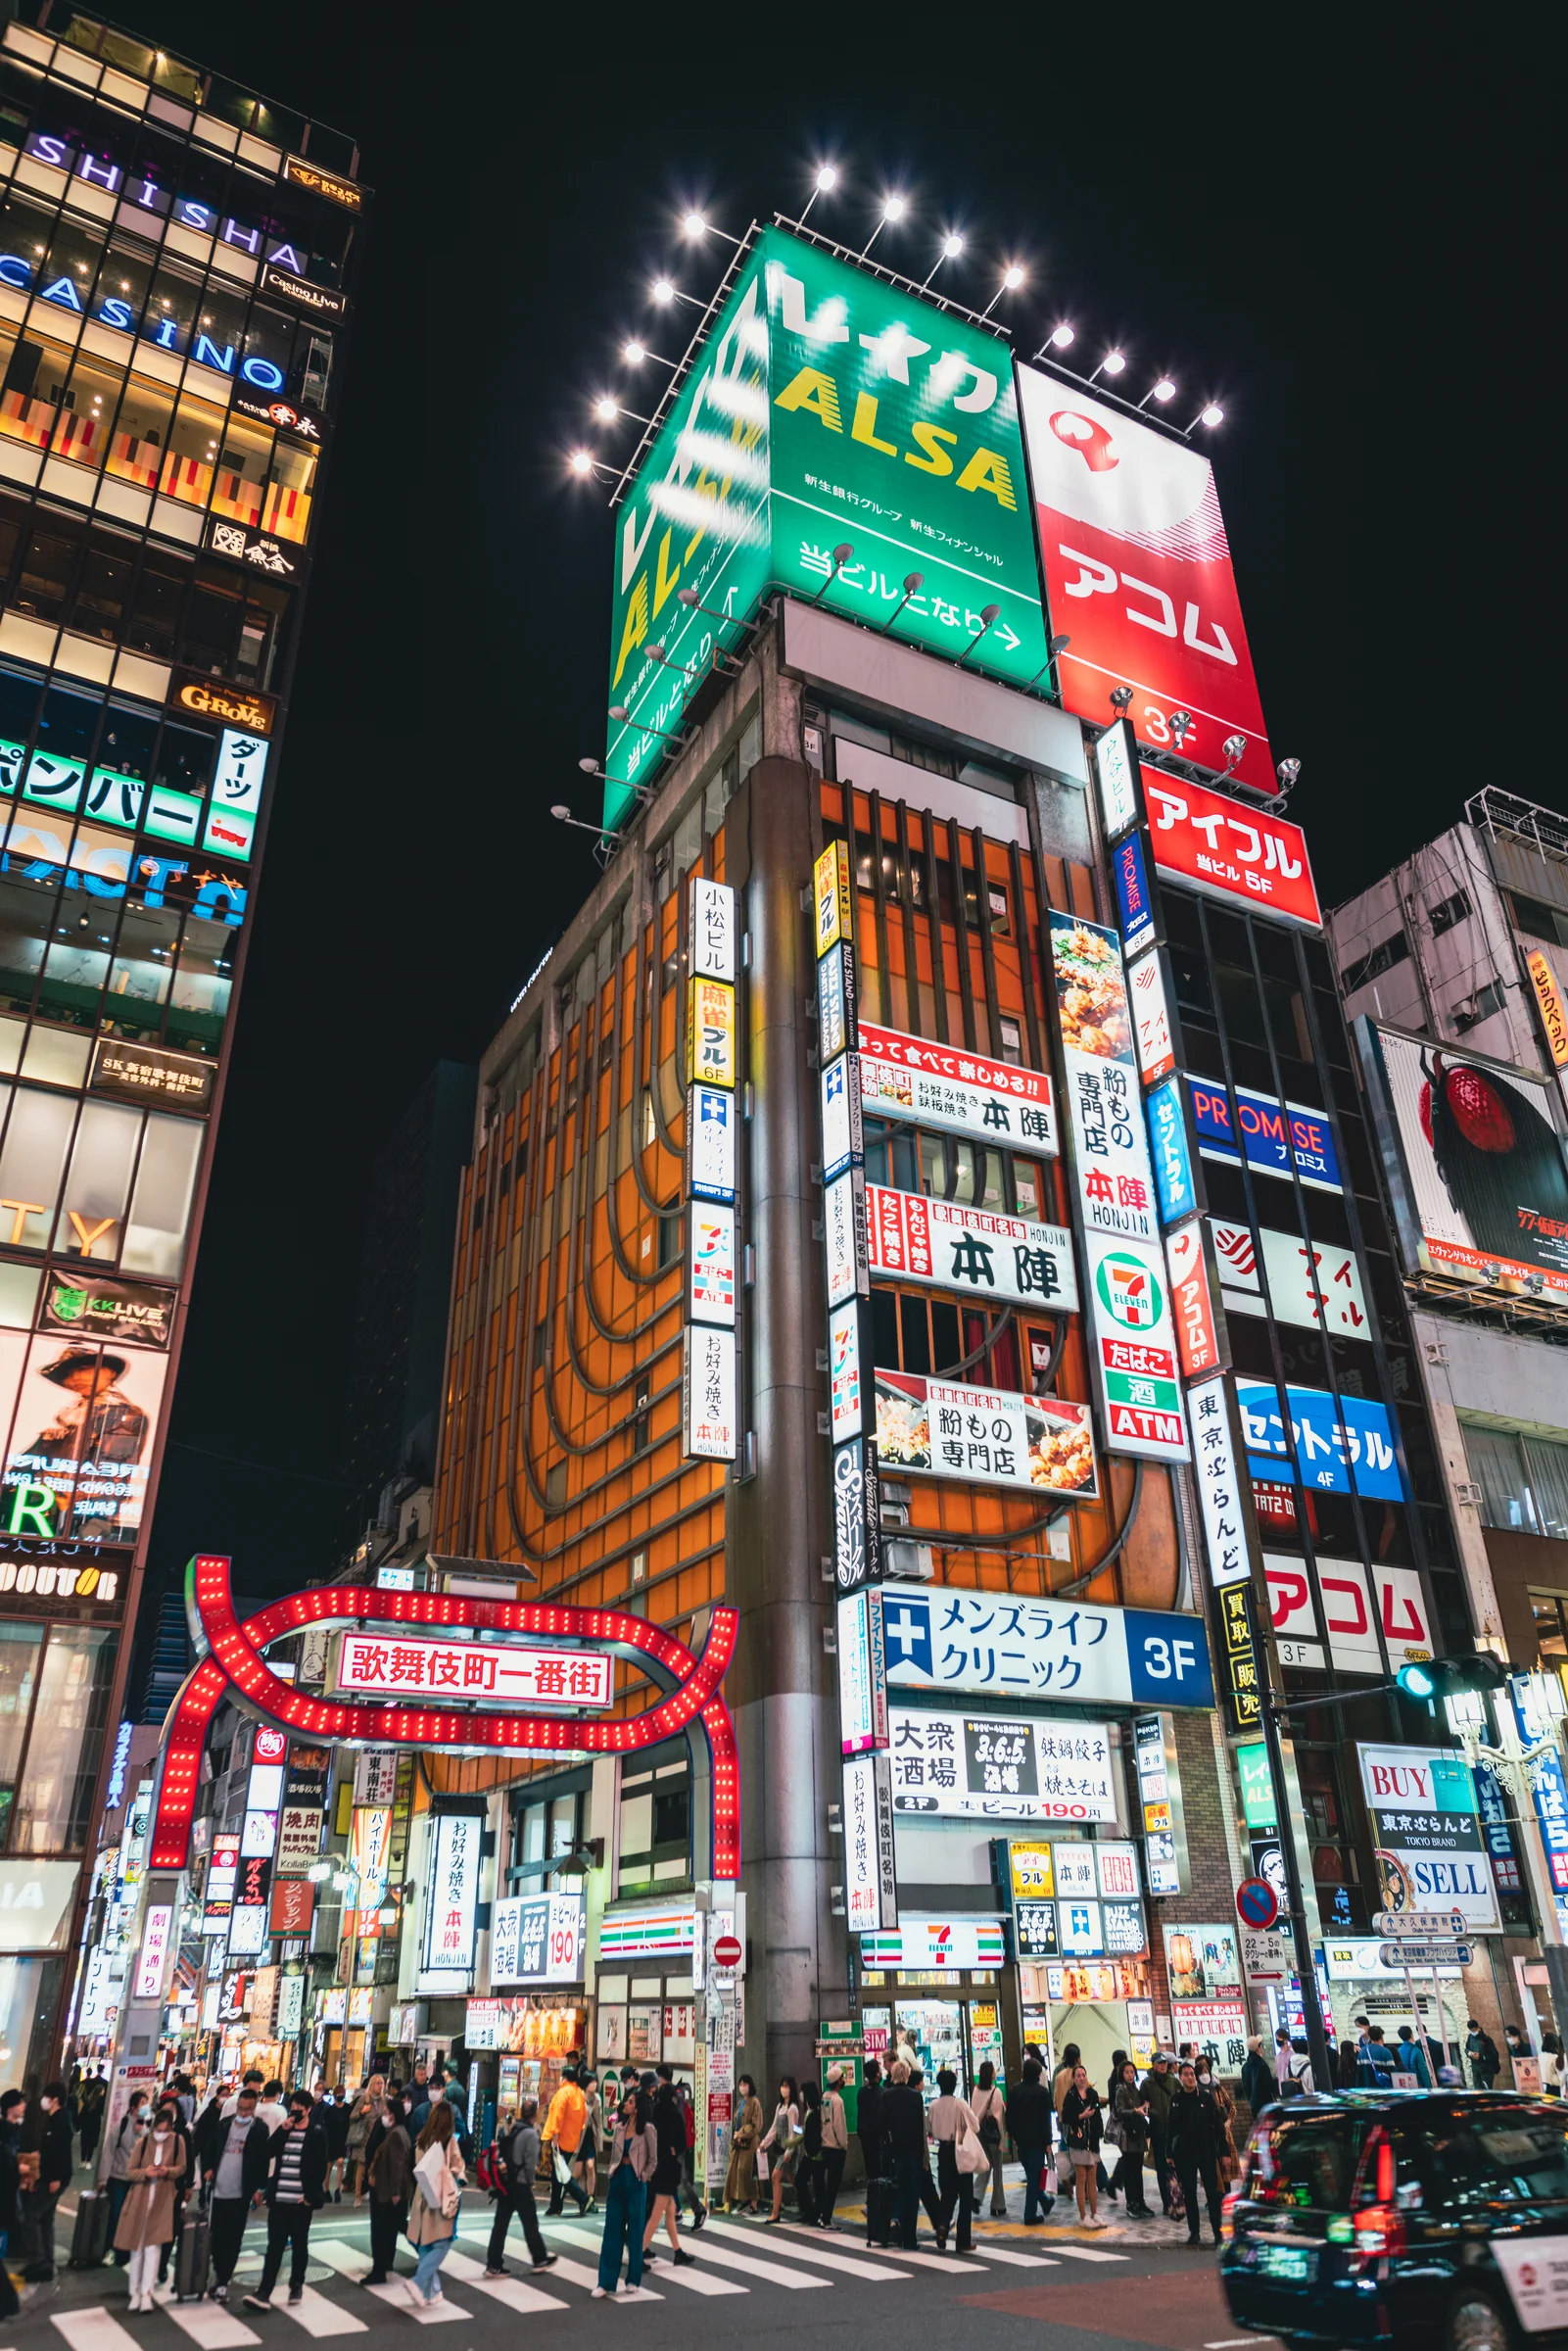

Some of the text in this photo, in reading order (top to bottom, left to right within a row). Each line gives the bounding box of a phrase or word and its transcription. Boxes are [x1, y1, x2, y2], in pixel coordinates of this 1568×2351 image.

[32, 135, 303, 274] SHISHA
[269, 273, 339, 310] Casino Live
[0, 254, 284, 391] CASINO
[782, 273, 998, 413] レイク
[774, 366, 1017, 511] ALSA
[804, 472, 1003, 566] 新生銀行グループ 新生フィナンシャル
[799, 541, 987, 638] 当ビルとなり
[1059, 544, 1238, 665] アコム
[181, 685, 265, 730] GROVE
[224, 740, 260, 798] ダーツ
[1148, 786, 1303, 880] アイフル
[839, 863, 849, 904] 麻雀ブル
[1121, 844, 1141, 914] PROMISE
[1196, 852, 1272, 894] 当ビル 5F
[818, 850, 835, 936] 麻雀ブル
[841, 907, 850, 916] 6F
[705, 888, 725, 971] 小松ビル
[822, 931, 833, 949] 6F
[1127, 911, 1148, 933] プロミス
[1134, 933, 1146, 948] 6F
[843, 944, 852, 968] BUZZ
[844, 968, 854, 999] STAND
[702, 984, 727, 1067] 麻雀ブル
[103, 1058, 205, 1088] SK 新宿歌舞伎町
[704, 1068, 724, 1080] 6F
[1153, 1062, 1165, 1079] 5F
[850, 1067, 861, 1152] メンズライフクリニック
[919, 1081, 978, 1107] お好み焼き
[919, 1094, 968, 1118] 鉄板焼き
[1103, 1066, 1133, 1150] 粉もの
[982, 1097, 1051, 1142] 本陣
[1076, 1072, 1109, 1157] 専門店
[1193, 1090, 1325, 1154] PROMISE
[852, 1153, 863, 1163] 3F
[1158, 1100, 1185, 1204] セントラル
[722, 1189, 734, 1198] 3F
[1084, 1167, 1149, 1212] 本陣
[855, 1192, 867, 1271] 歌舞伎町名物
[881, 1193, 901, 1266] たこ焼き
[909, 1199, 928, 1273] もんじゃ焼き
[1029, 1230, 1066, 1247] HONJIN
[1093, 1204, 1149, 1234] HONJIN
[950, 1230, 1062, 1299] 本陣
[701, 1290, 724, 1304] ATM
[1181, 1280, 1207, 1350] アコム
[705, 1335, 722, 1420] お好み焼き
[1110, 1343, 1167, 1375] たばこ
[1192, 1350, 1209, 1368] 3F
[837, 1401, 855, 1420] ATM
[1128, 1377, 1156, 1406] 酒
[696, 1422, 730, 1442] 本陣
[939, 1408, 1012, 1443] 粉もの
[1117, 1410, 1179, 1442] ATM
[1240, 1405, 1395, 1470] セントラル
[697, 1443, 729, 1456] HONJIN
[941, 1439, 1016, 1475] 専門店
[865, 1468, 879, 1529] Sparkle
[1317, 1471, 1334, 1487] 4F
[869, 1530, 879, 1575] スパークル
[0, 1562, 118, 1601] DOUTOR
[939, 1598, 1108, 1647] メンズライフ
[1227, 1593, 1251, 1645] 買取
[1265, 1570, 1426, 1643] アコム
[871, 1605, 884, 1693] ファイトフィット
[941, 1643, 1082, 1690] クリニック
[1144, 1637, 1196, 1680] 3F
[1283, 1644, 1307, 1663] 3F
[352, 1644, 601, 1698] 歌舞伎町一番街
[894, 1719, 956, 1751] 大衆
[1041, 1737, 1106, 1761] 鉄鍋餃子
[365, 1756, 381, 1802] 東南荘
[894, 1755, 957, 1789] 酒場
[1044, 1775, 1108, 1797] 焼きそば
[1370, 1765, 1428, 1798] BUY
[904, 1797, 929, 1809] 2F
[853, 1770, 868, 1882] お好み焼き
[879, 1786, 893, 1896] 歌舞伎町名物
[1404, 1837, 1456, 1847] TOKYO BRAND
[449, 1821, 467, 1904] お好み焼き
[1060, 1865, 1091, 1881] 本陣
[1413, 1861, 1488, 1895] SELL
[360, 1911, 376, 1923] 1F
[851, 1888, 875, 1910] 本陣
[358, 1924, 375, 1936] 2F
[444, 1909, 462, 1948] 本陣
[1399, 1917, 1449, 1927] 大久保病院
[144, 1913, 166, 1989] 劇場通り
[435, 1953, 466, 1964] HONJIN
[865, 2034, 885, 2049] SIM
[973, 2033, 989, 2042] たばこ
